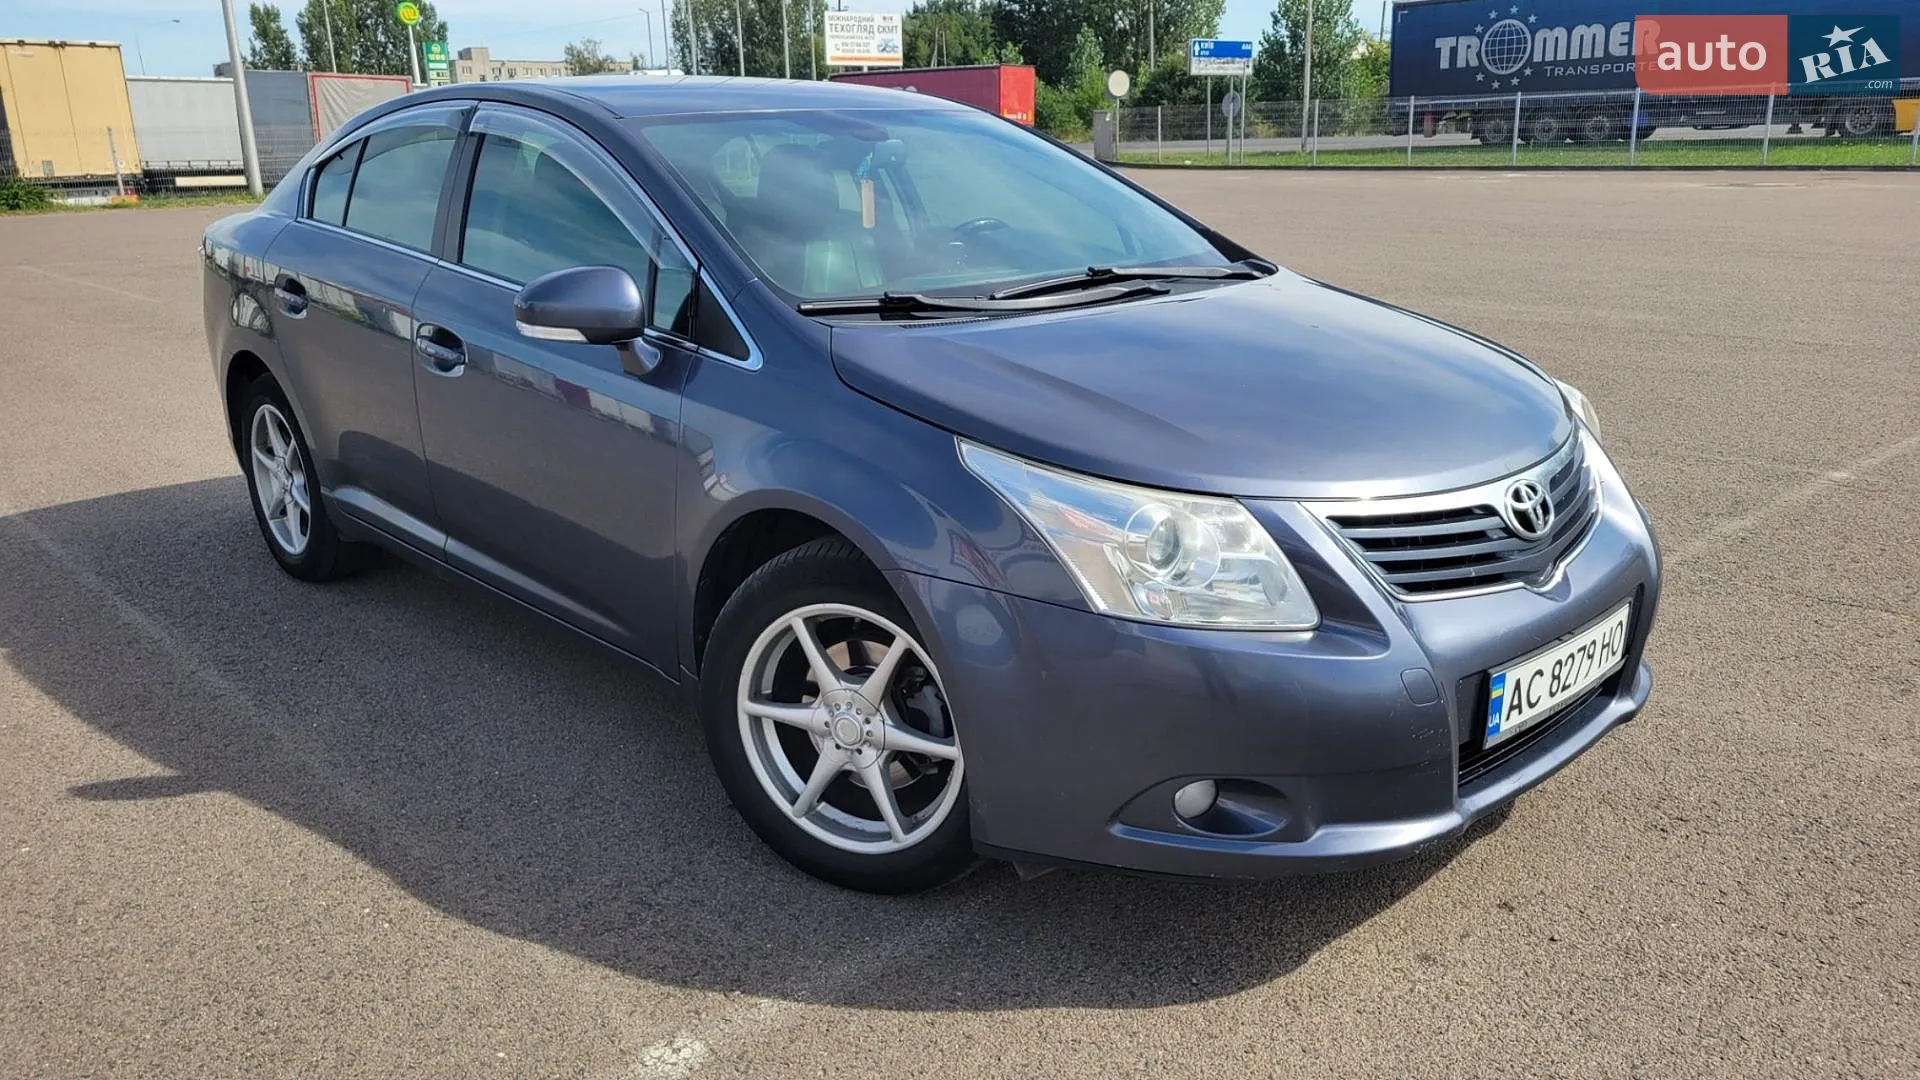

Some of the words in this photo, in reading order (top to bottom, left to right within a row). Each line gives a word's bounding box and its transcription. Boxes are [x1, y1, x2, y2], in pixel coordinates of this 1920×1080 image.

[829, 24, 875, 35] ТЕХОГЛЯД
[1435, 19, 1661, 75] TROMMER
[1506, 669, 1544, 721] AC
[1549, 639, 1597, 698] 8279
[1599, 620, 1624, 668] HO
[1489, 711, 1500, 727] UA
